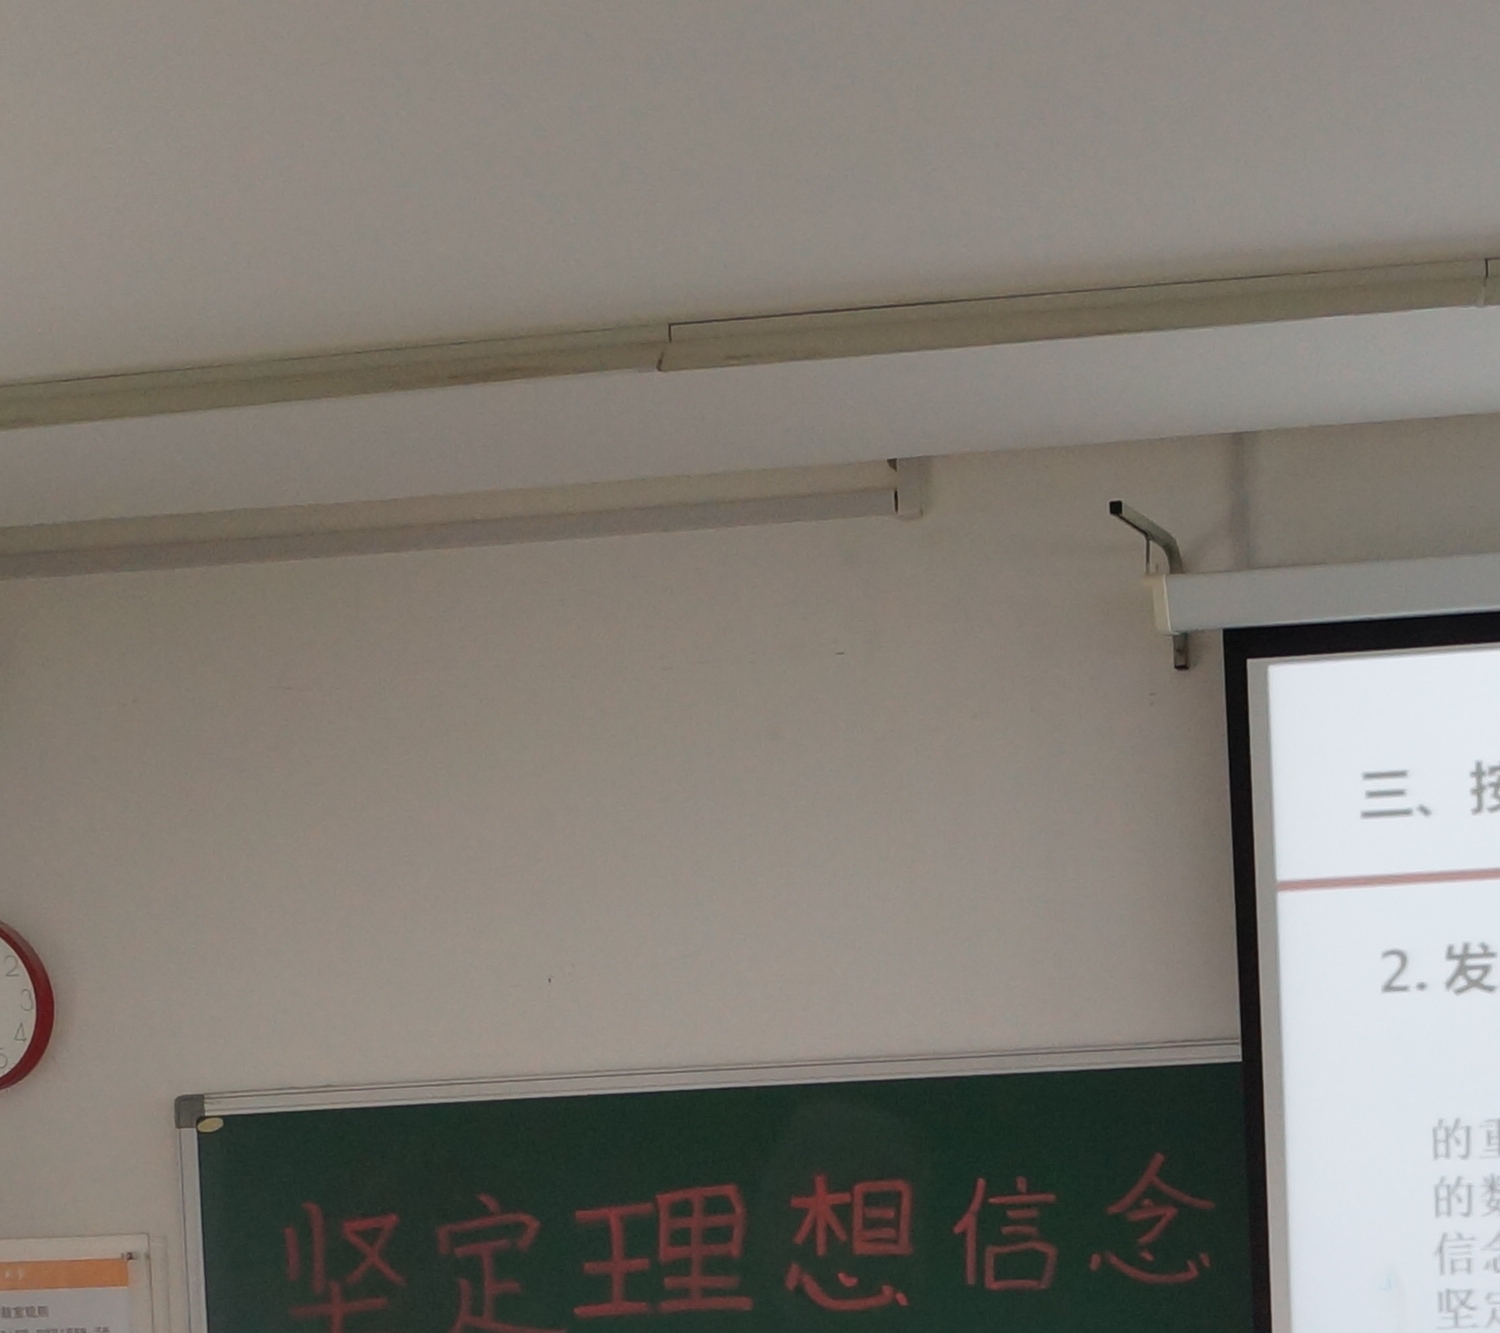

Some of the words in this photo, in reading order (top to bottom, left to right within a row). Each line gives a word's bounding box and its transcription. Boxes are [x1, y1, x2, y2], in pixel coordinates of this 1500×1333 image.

[4, 955, 20, 977] 2
[20, 988, 34, 1012] 3
[13, 1022, 27, 1043] 4
